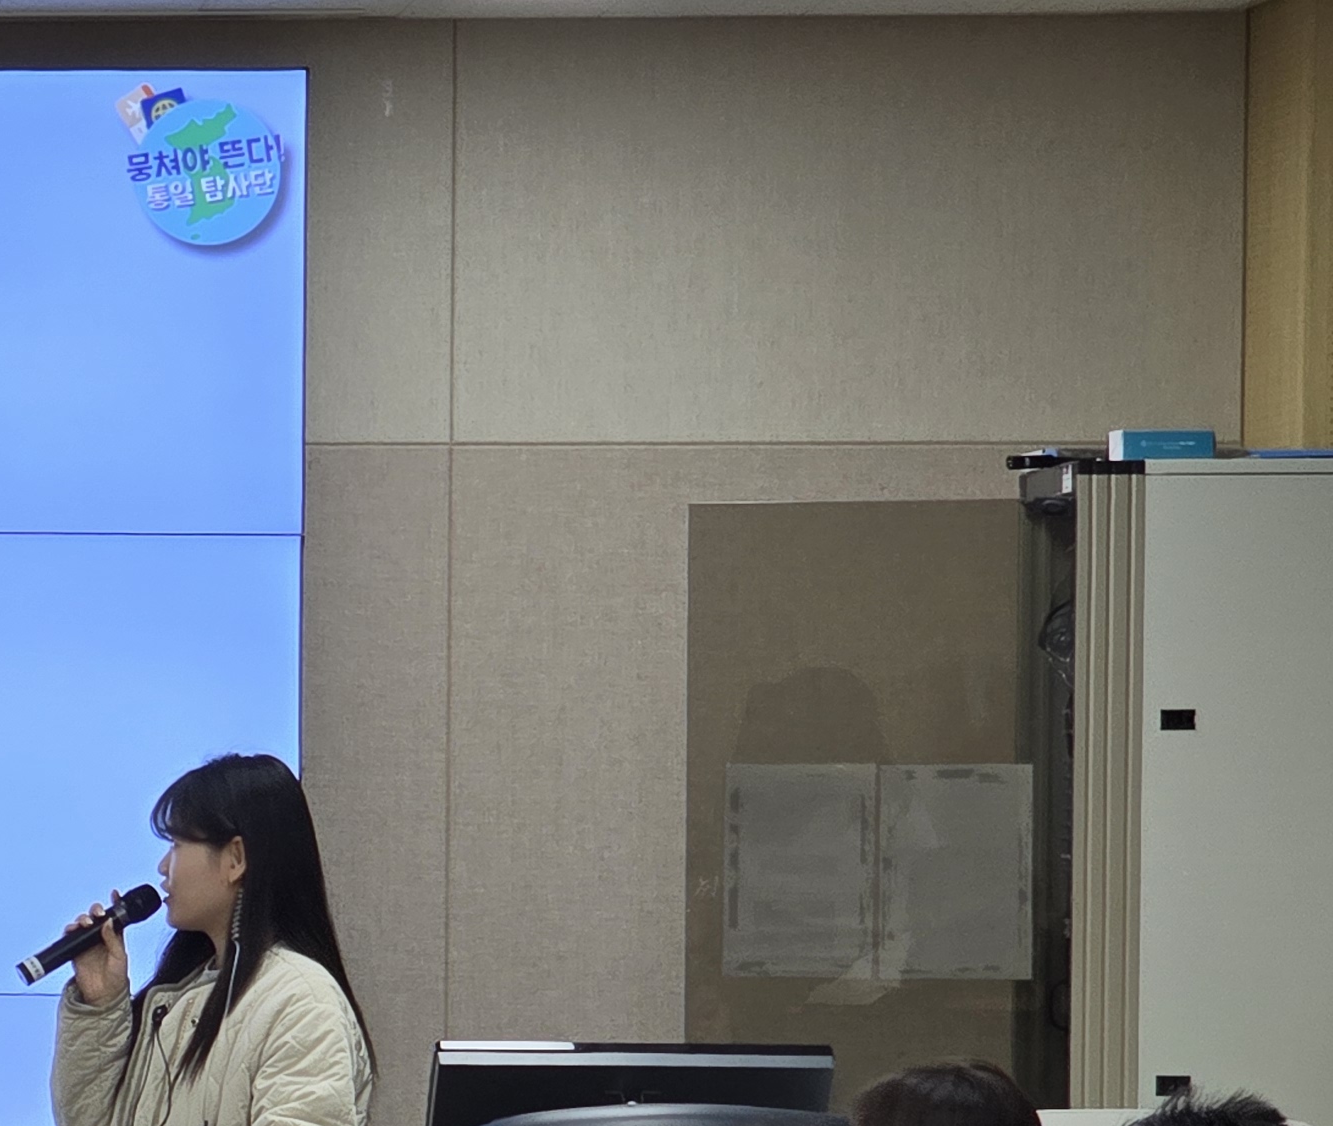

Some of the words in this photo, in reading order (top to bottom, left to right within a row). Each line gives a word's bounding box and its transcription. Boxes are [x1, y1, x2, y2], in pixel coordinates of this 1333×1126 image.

[127, 145, 210, 182] 뭉쳐야
[219, 134, 286, 169] 뜬다!
[147, 181, 195, 211] 통일
[201, 170, 275, 204] 탐사단
